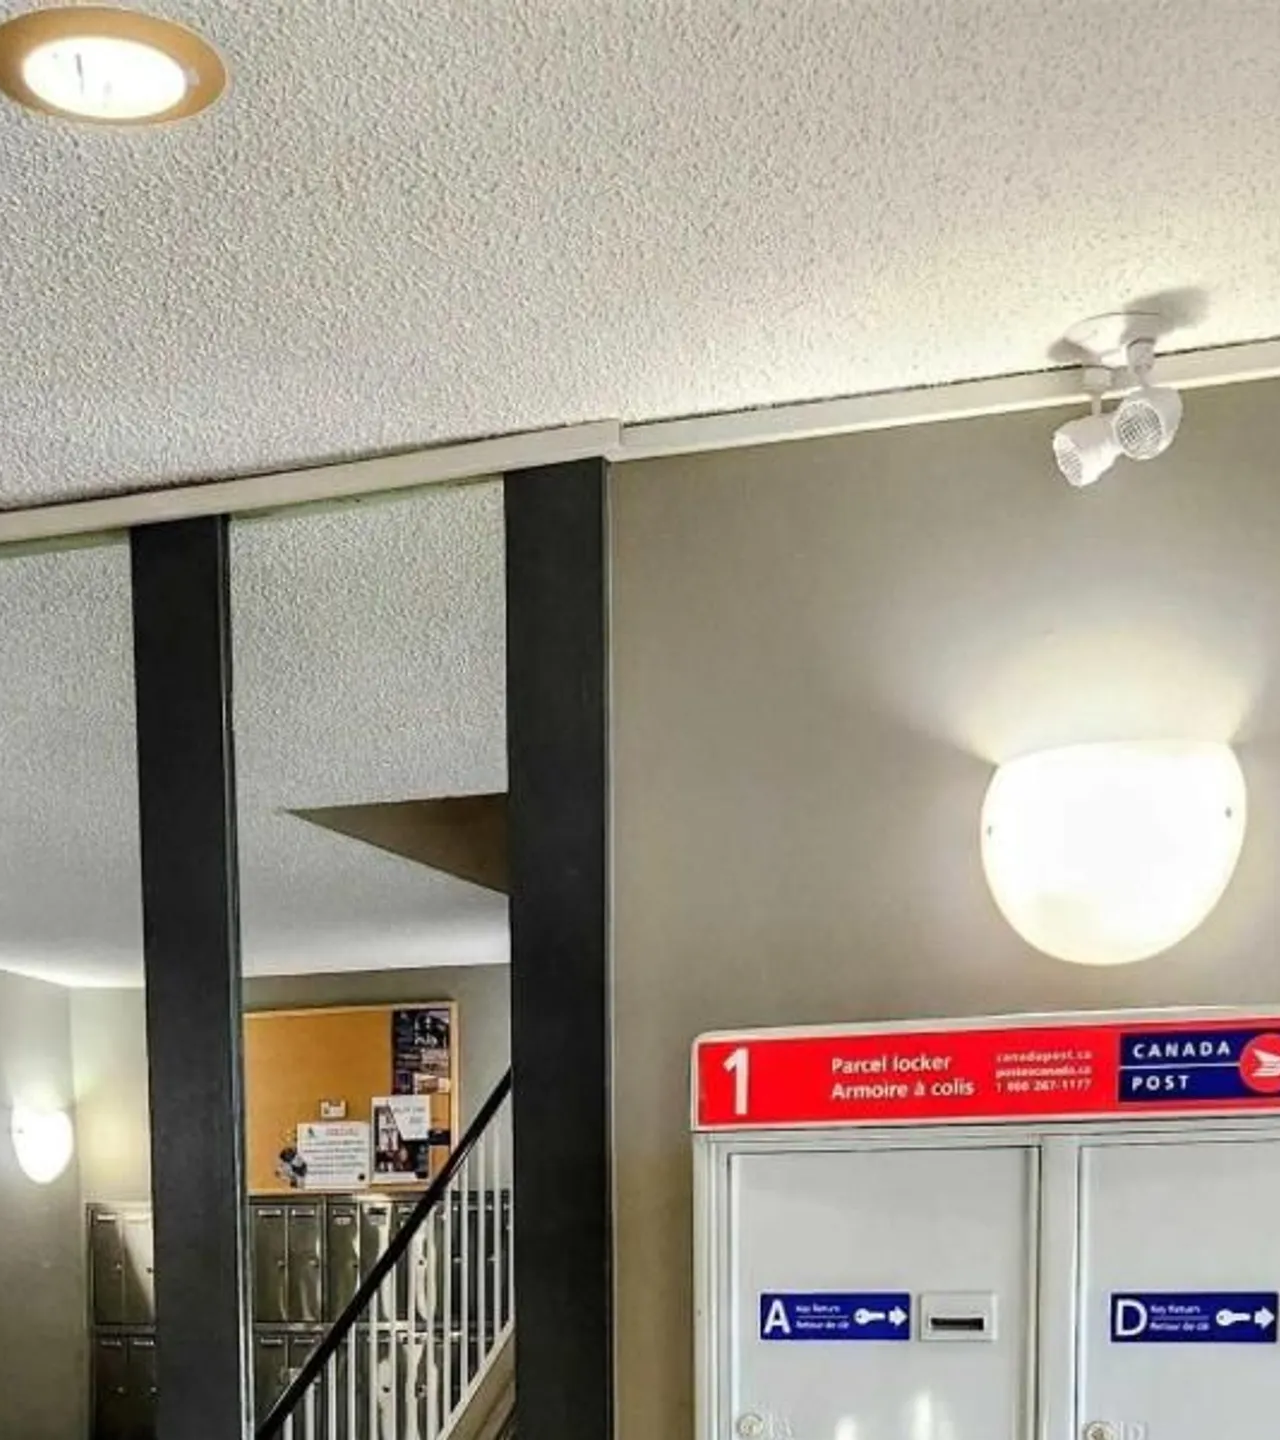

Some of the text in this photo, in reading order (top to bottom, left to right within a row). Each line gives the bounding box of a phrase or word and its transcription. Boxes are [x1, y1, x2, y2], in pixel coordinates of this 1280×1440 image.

[1132, 1040, 1232, 1060] CANADA
[831, 1052, 952, 1075] Parcel locker
[723, 1046, 749, 1115] 1
[831, 1076, 976, 1101] Armoire à colis
[1131, 1073, 1190, 1091] POST
[763, 1298, 792, 1335] A
[1116, 1298, 1149, 1337] D
